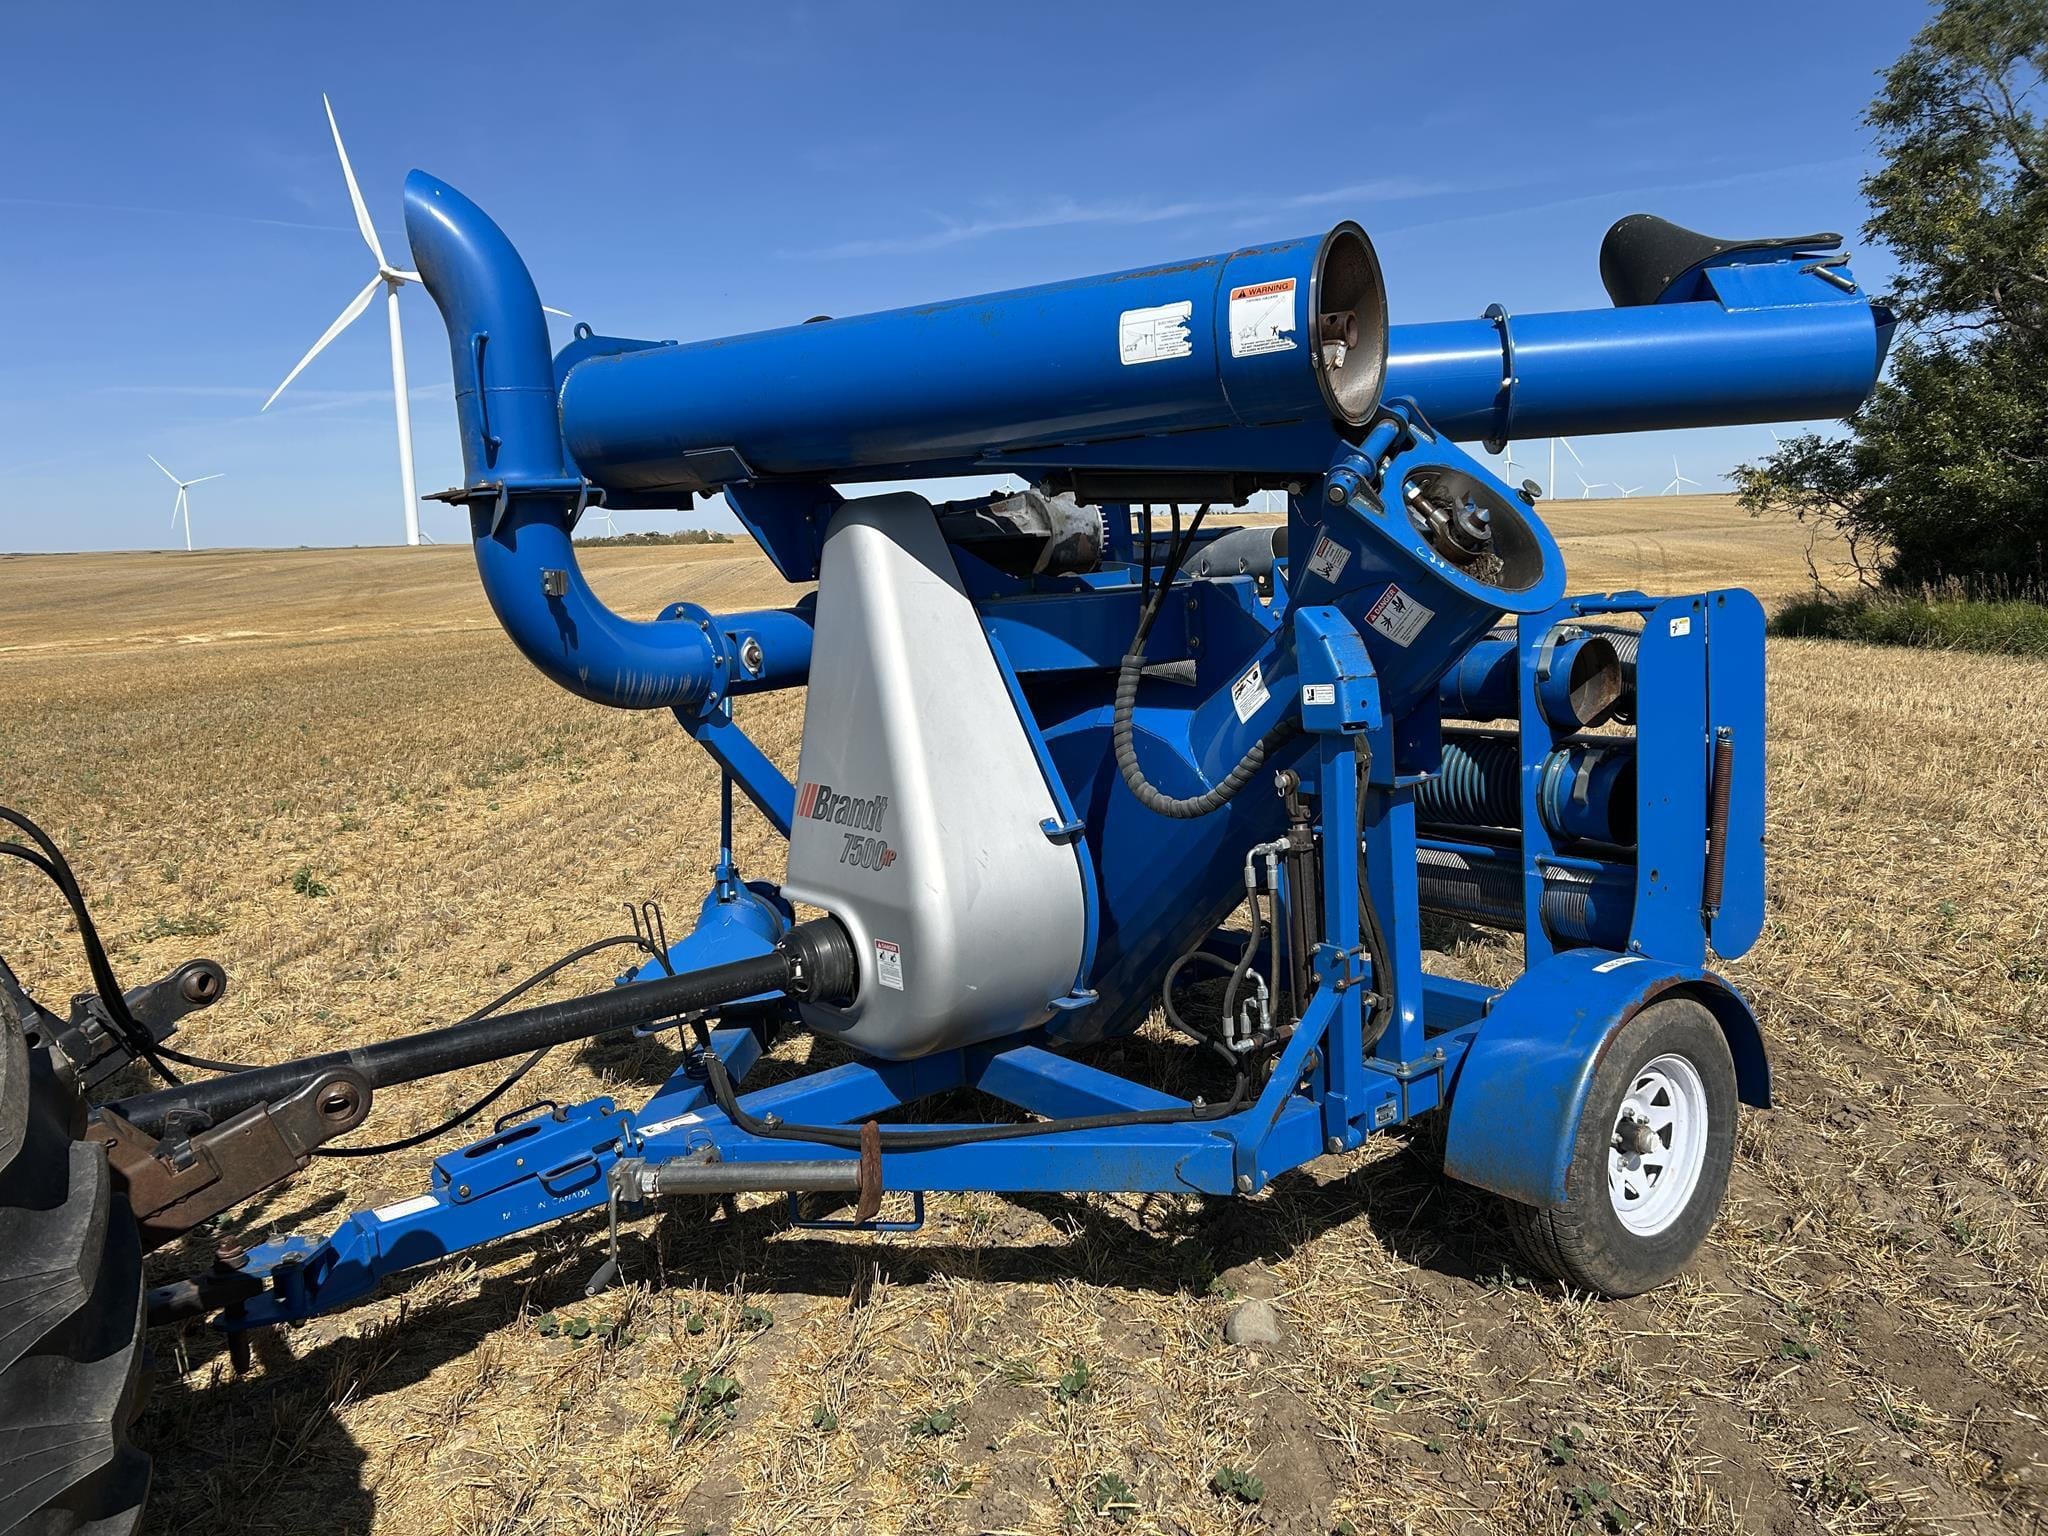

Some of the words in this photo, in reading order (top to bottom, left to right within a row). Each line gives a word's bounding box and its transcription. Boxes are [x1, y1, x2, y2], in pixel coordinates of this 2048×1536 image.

[1249, 283, 1288, 295] WARNING
[1375, 589, 1396, 614] DANGER
[811, 784, 888, 832] Brandt
